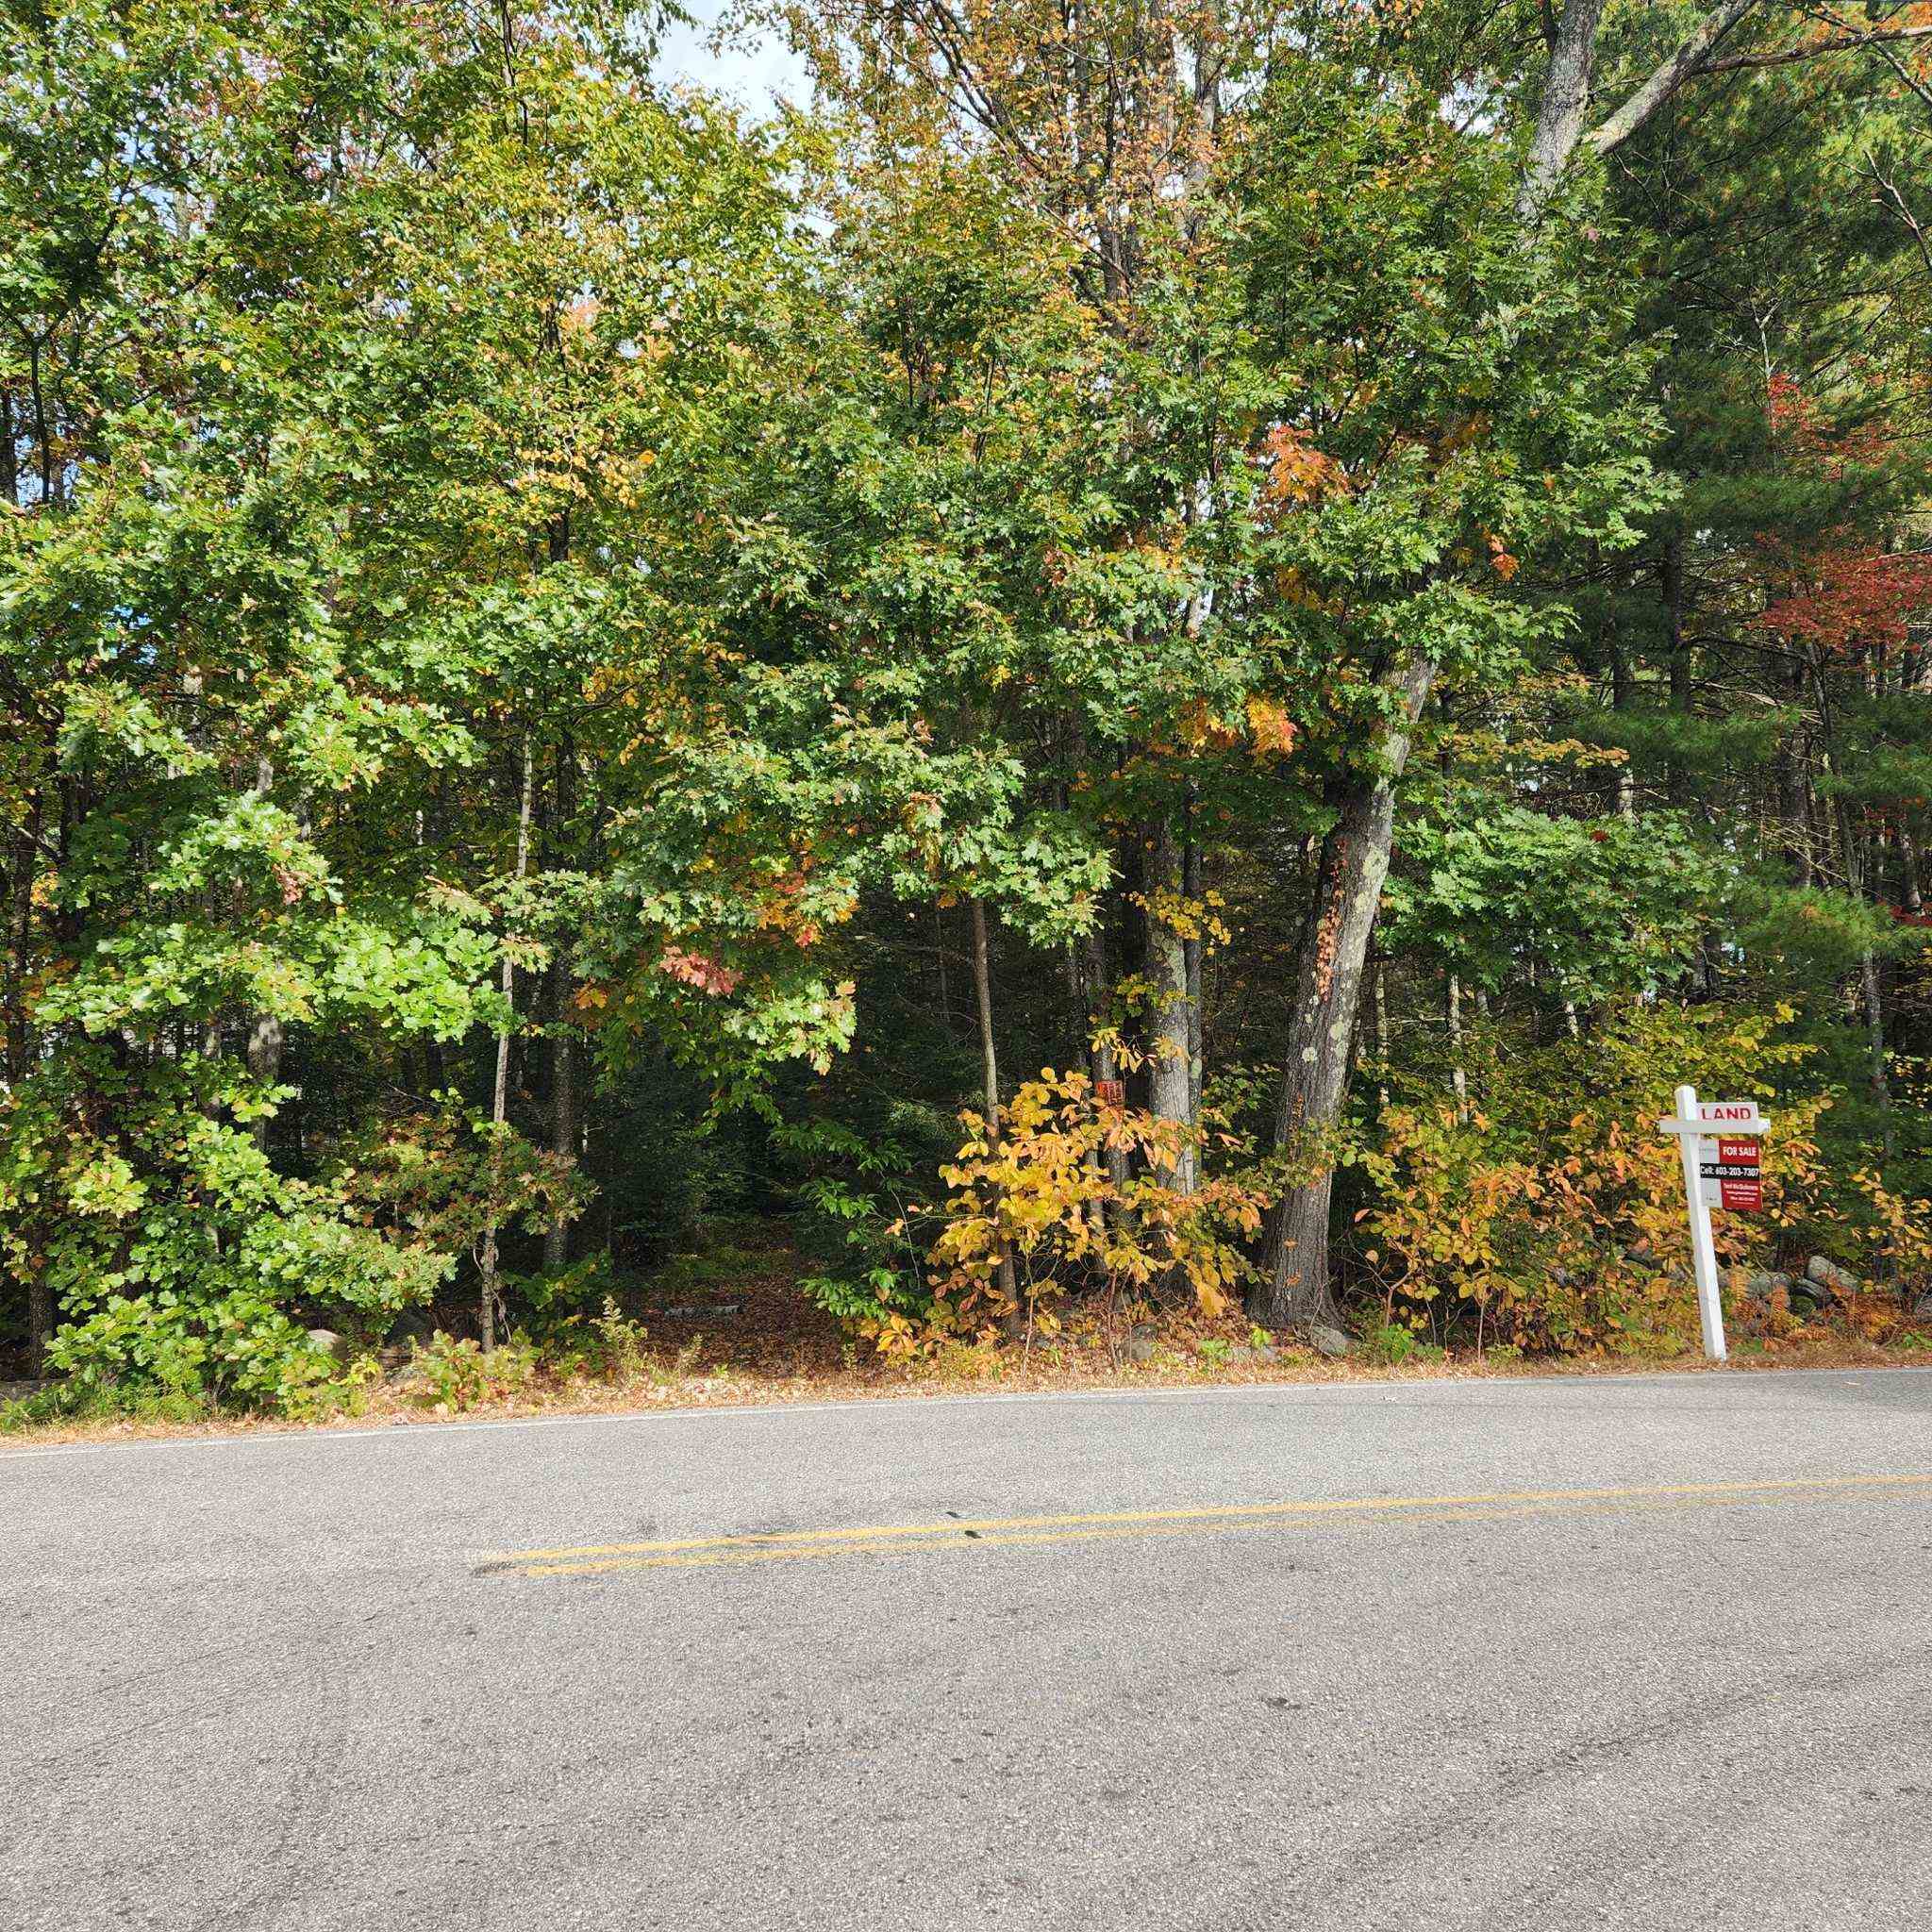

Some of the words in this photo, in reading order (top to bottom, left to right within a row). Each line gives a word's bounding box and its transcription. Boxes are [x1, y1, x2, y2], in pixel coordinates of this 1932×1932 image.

[1701, 1108, 1751, 1120] LAND
[1723, 1146, 1737, 1156] FOR
[1739, 1147, 1757, 1157] SALE
